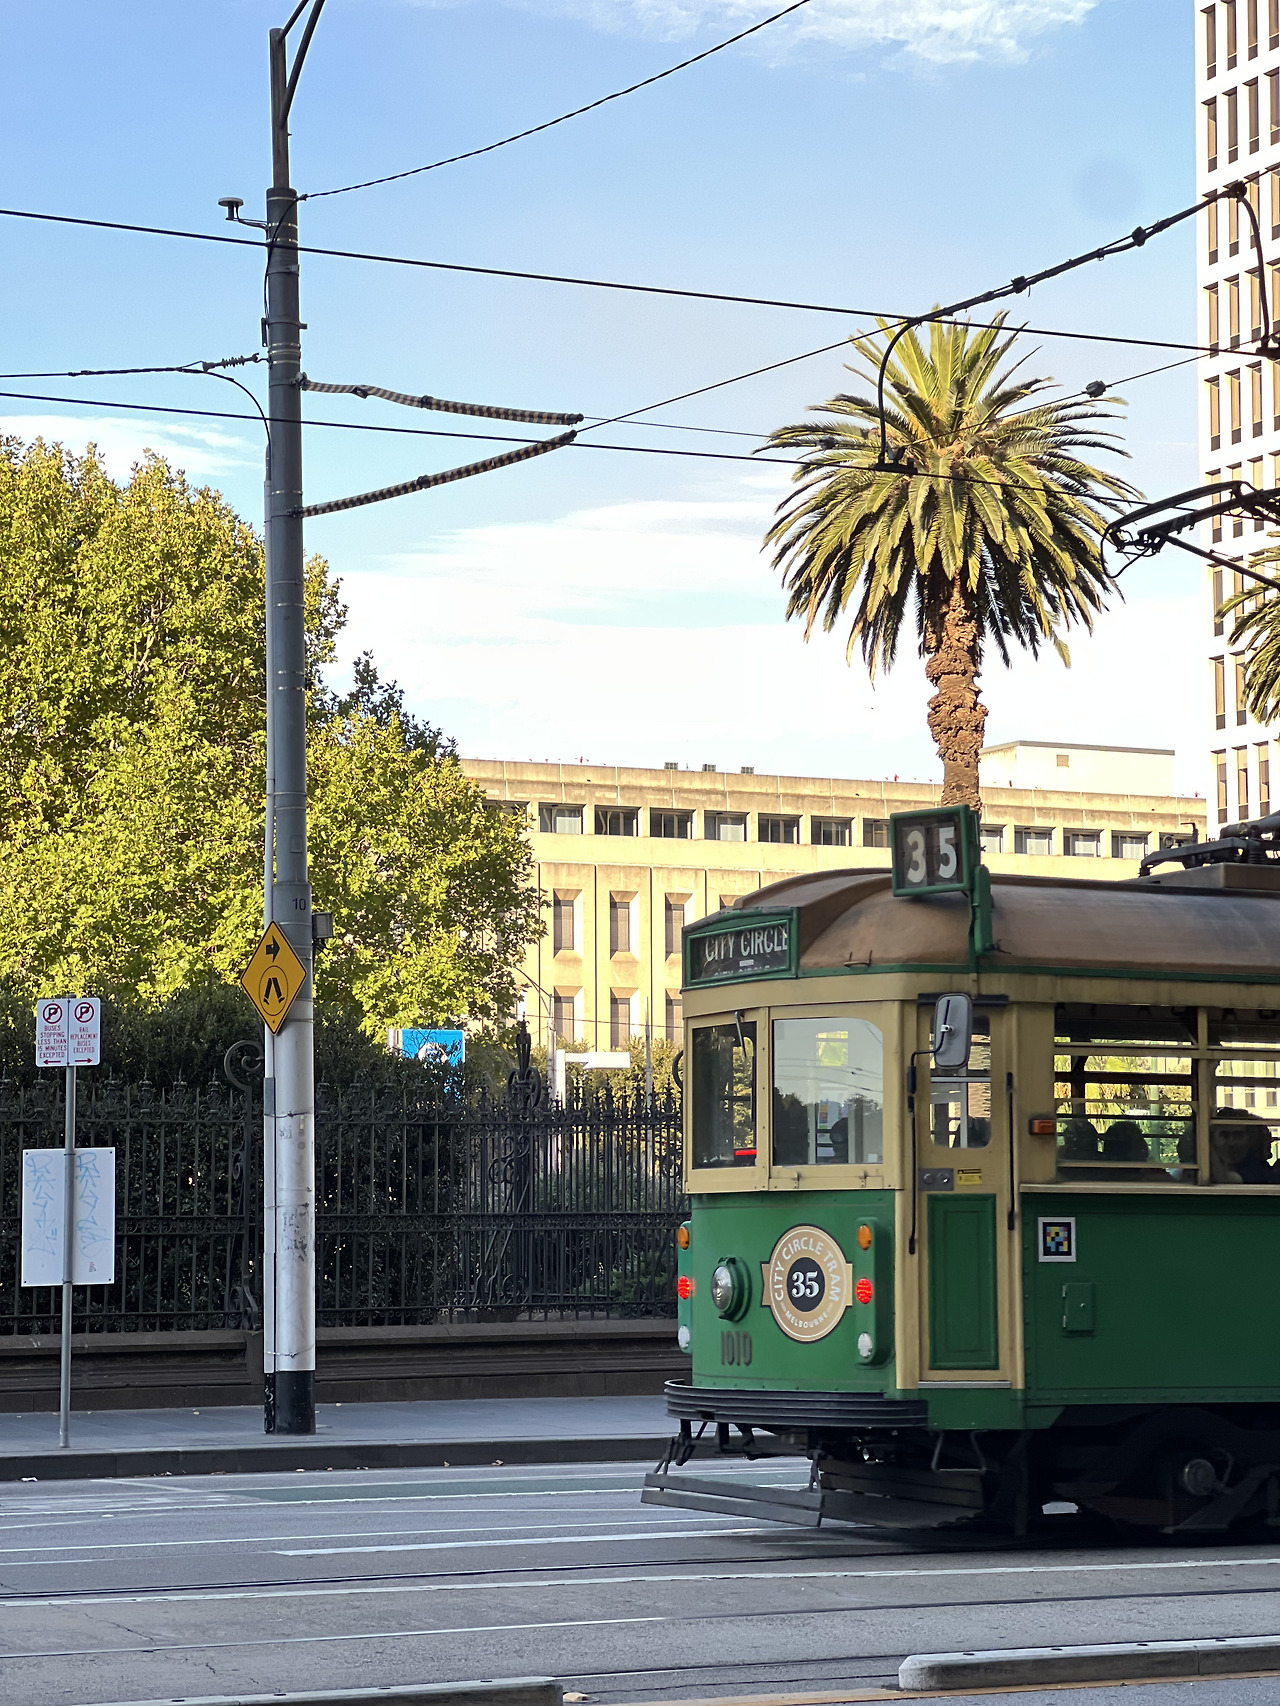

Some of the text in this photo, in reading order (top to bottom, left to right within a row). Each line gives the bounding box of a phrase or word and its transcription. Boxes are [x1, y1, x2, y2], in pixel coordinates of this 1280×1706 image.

[907, 826, 957, 883] 35
[292, 898, 306, 911] 10
[705, 925, 788, 961] CITY CIRCLE
[774, 1237, 841, 1302] CITY CIRCLE TRAM
[791, 1271, 820, 1298] 35
[784, 1310, 828, 1328] MELBOURNE
[721, 1331, 753, 1366] 1010
